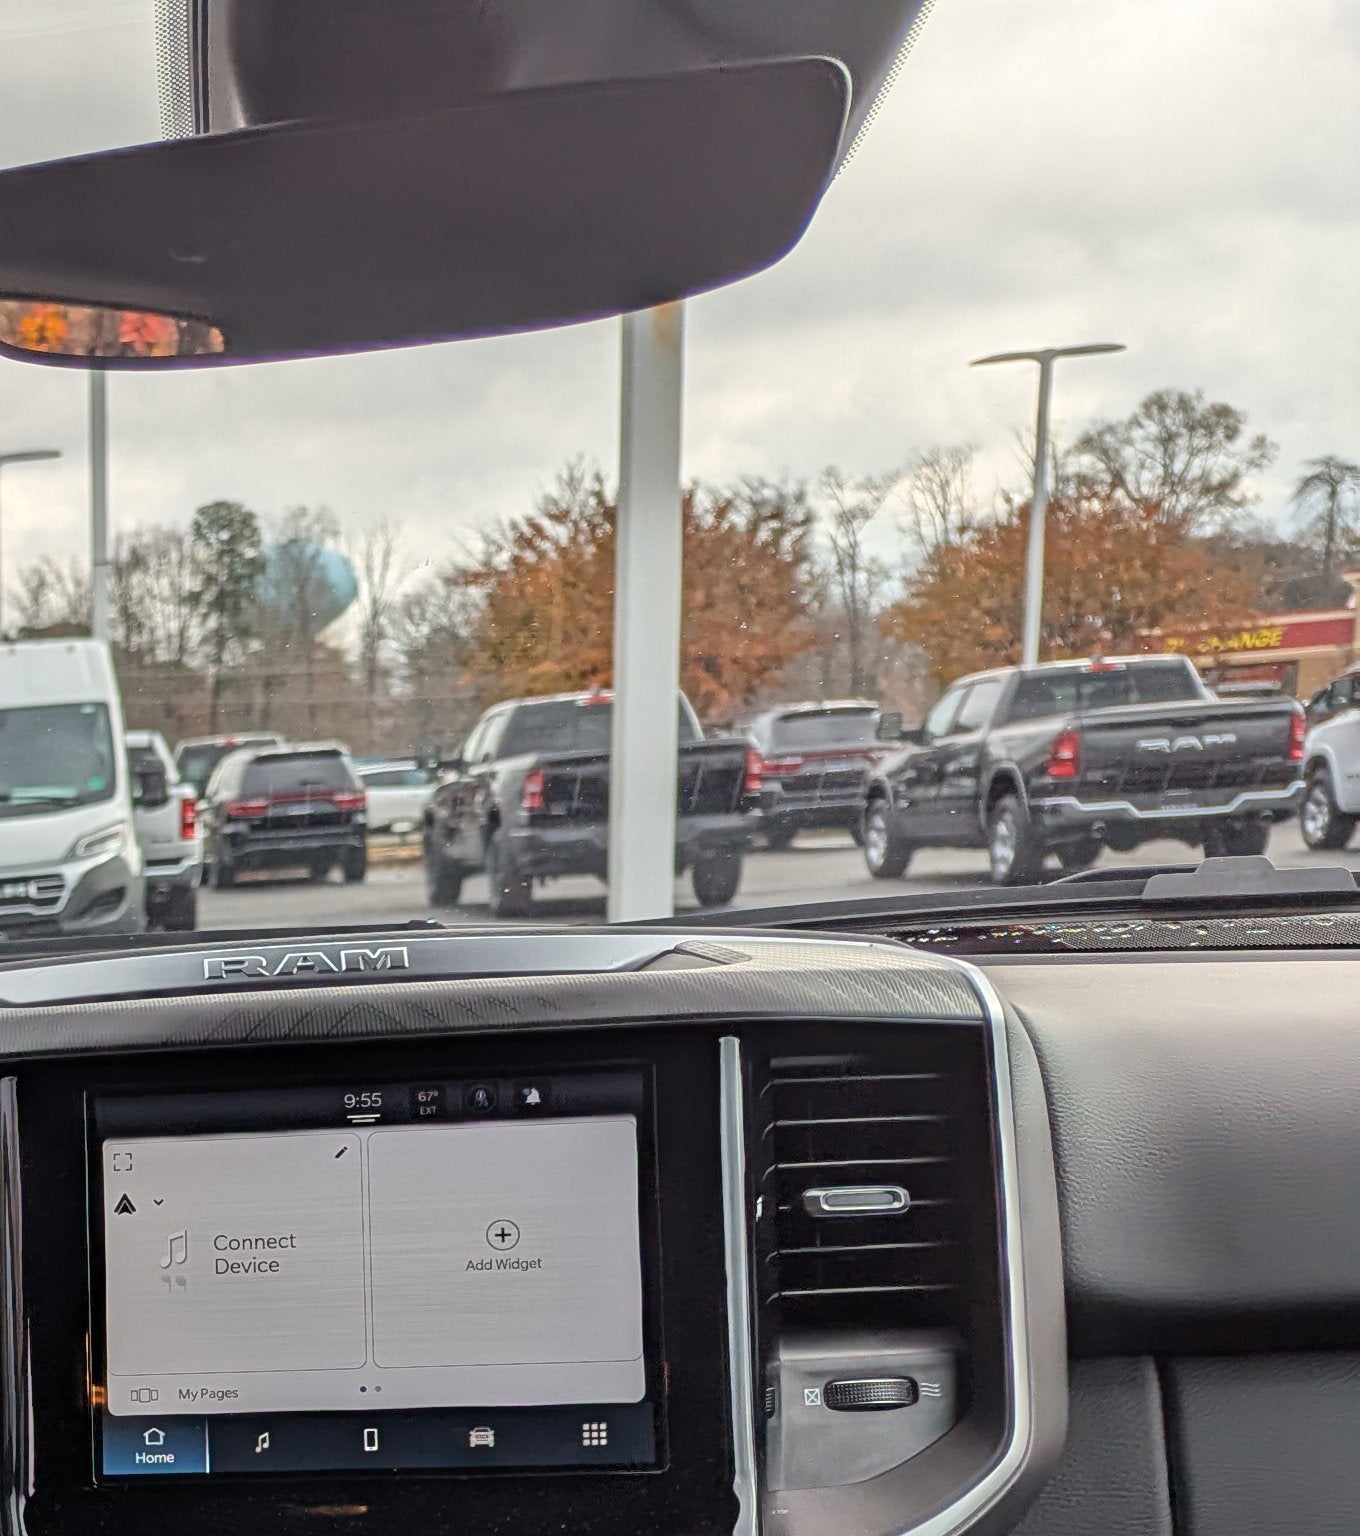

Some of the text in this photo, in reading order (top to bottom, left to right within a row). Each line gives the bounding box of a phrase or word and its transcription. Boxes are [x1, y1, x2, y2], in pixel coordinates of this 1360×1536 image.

[203, 946, 409, 980] RAM
[344, 1093, 382, 1109] 9:55
[213, 1233, 296, 1251] Connect
[215, 1256, 280, 1275] Device
[465, 1258, 543, 1272] Add Widget
[178, 1388, 239, 1401] My Pages
[135, 1452, 175, 1464] Home
